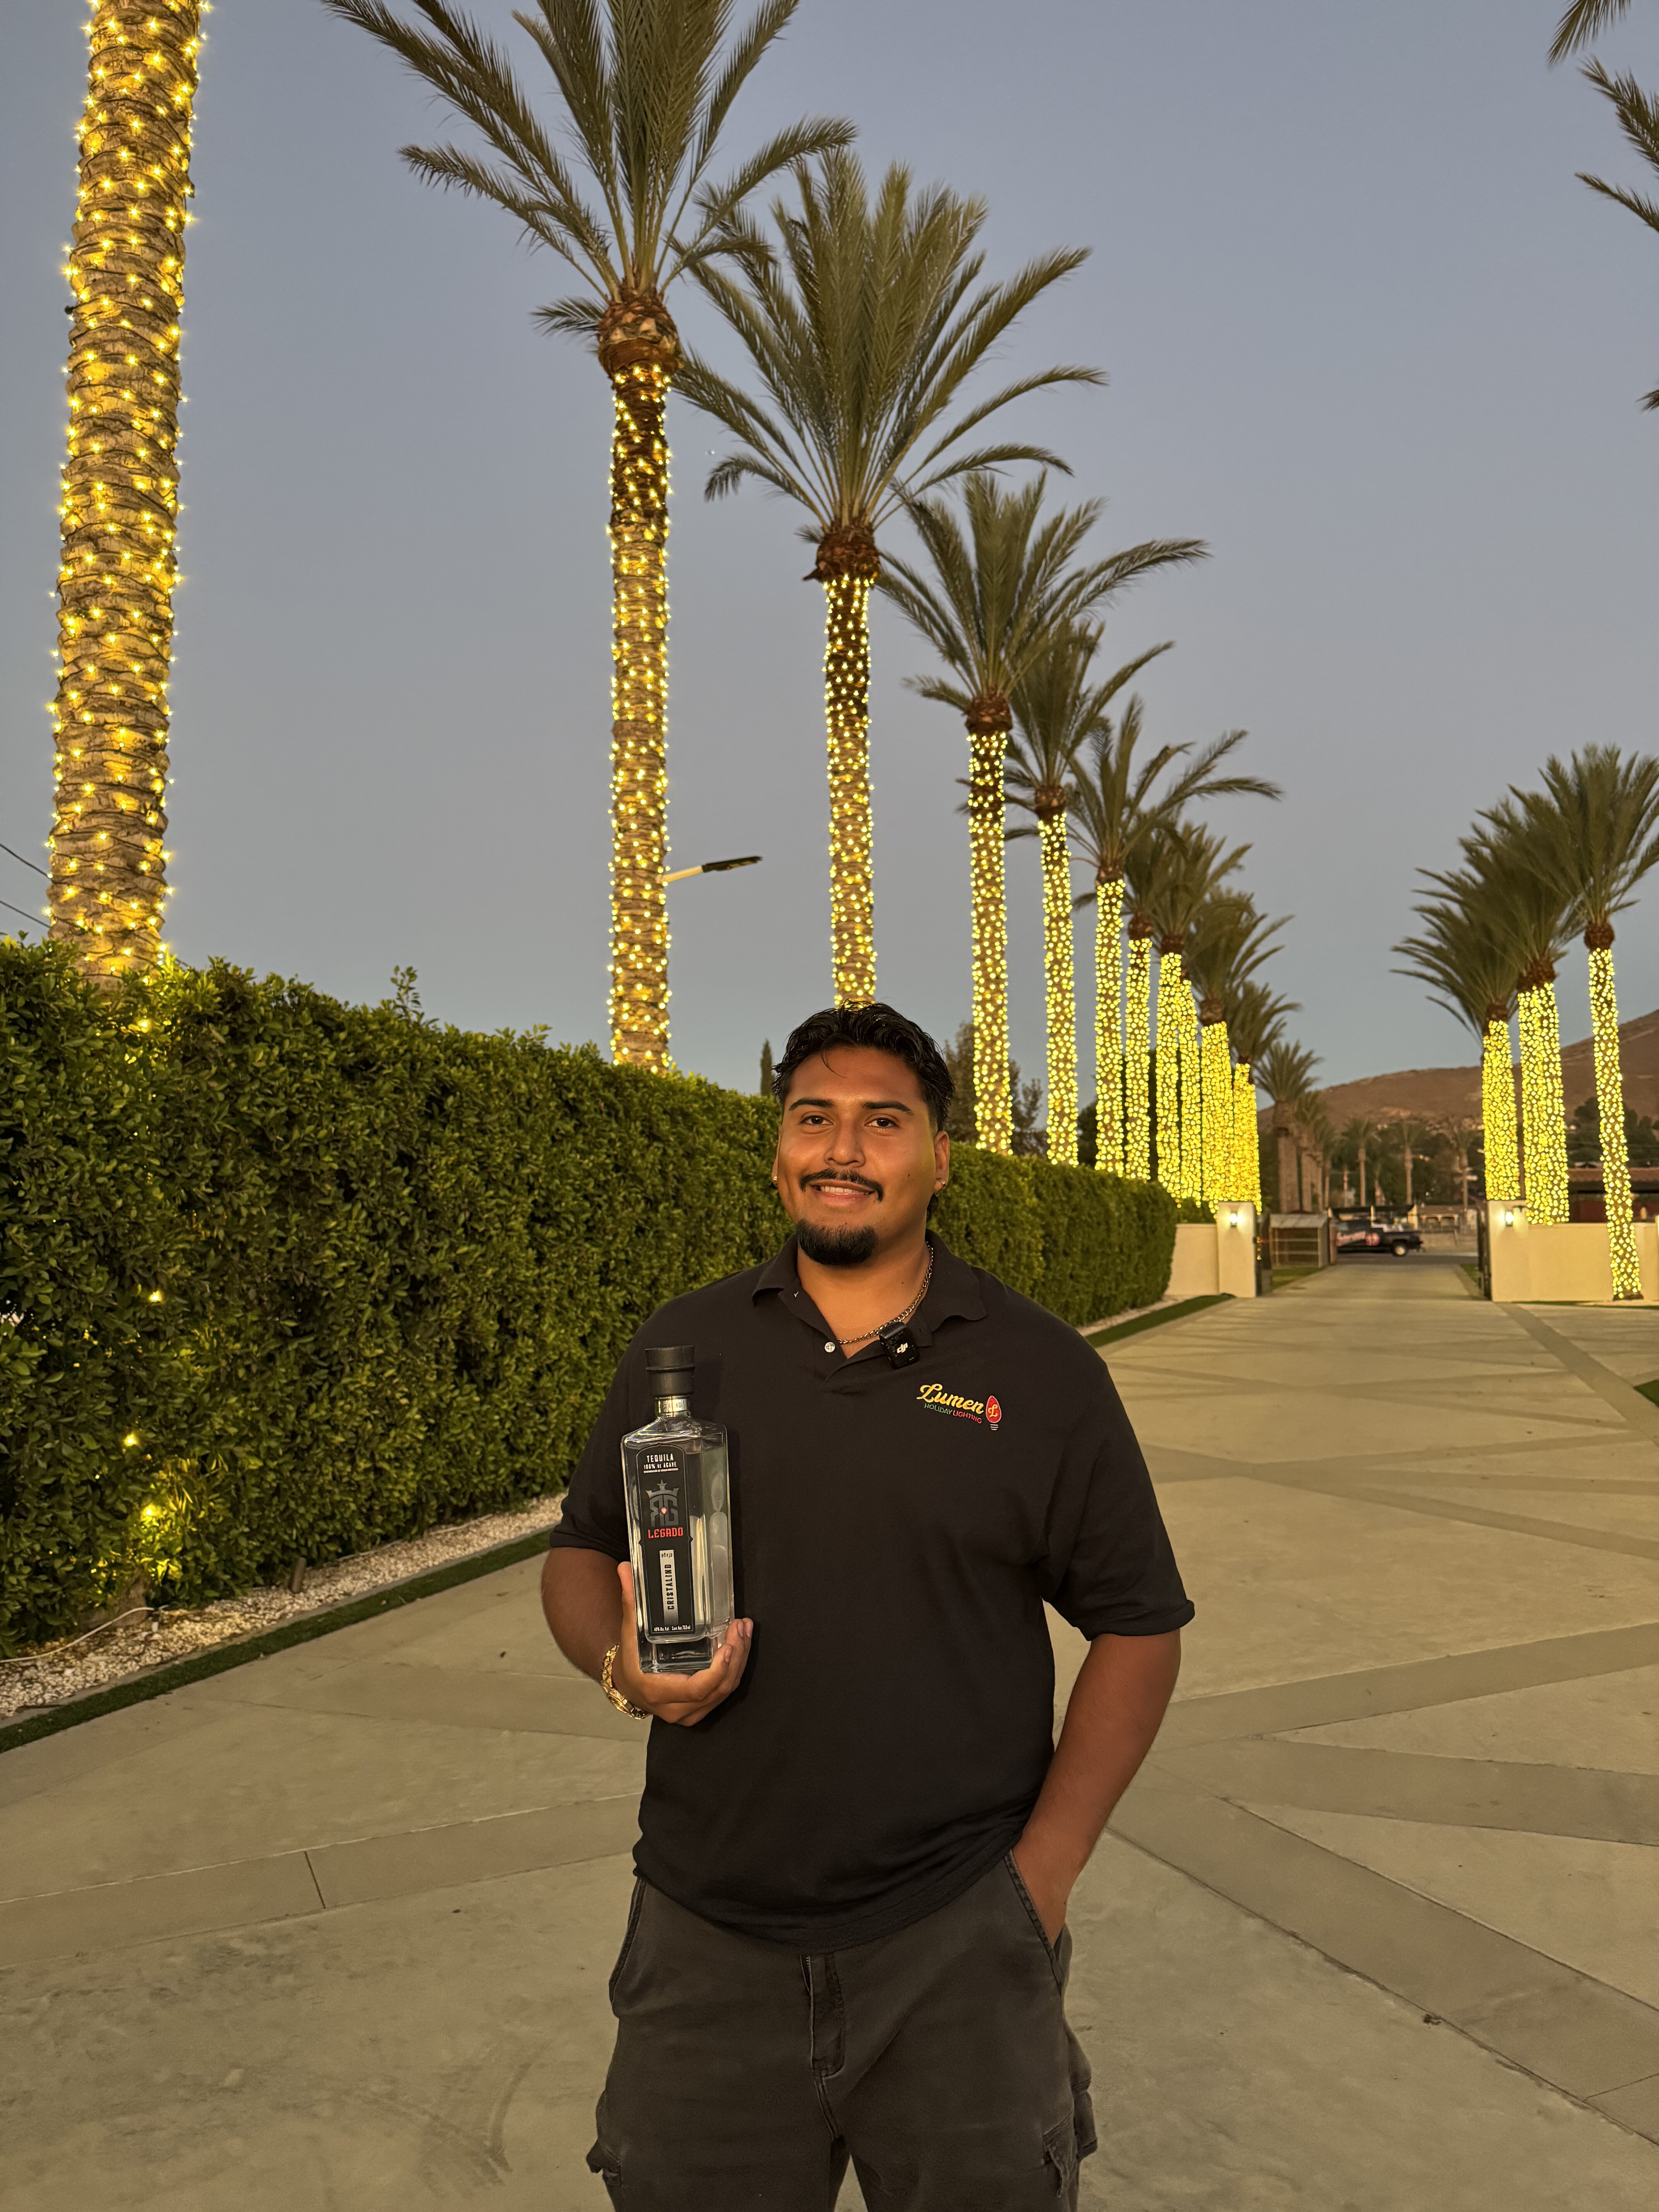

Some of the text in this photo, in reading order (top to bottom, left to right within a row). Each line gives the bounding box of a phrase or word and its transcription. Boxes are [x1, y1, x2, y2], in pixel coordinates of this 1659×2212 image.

[916, 1384, 984, 1414] Lumen
[924, 1403, 982, 1424] HOLIDAY LIGHTING
[988, 1404, 998, 1417] L
[647, 1453, 674, 1463] TEQUILA
[647, 1527, 683, 1539] LEGADO
[665, 1565, 675, 1610] CRISTALINO
